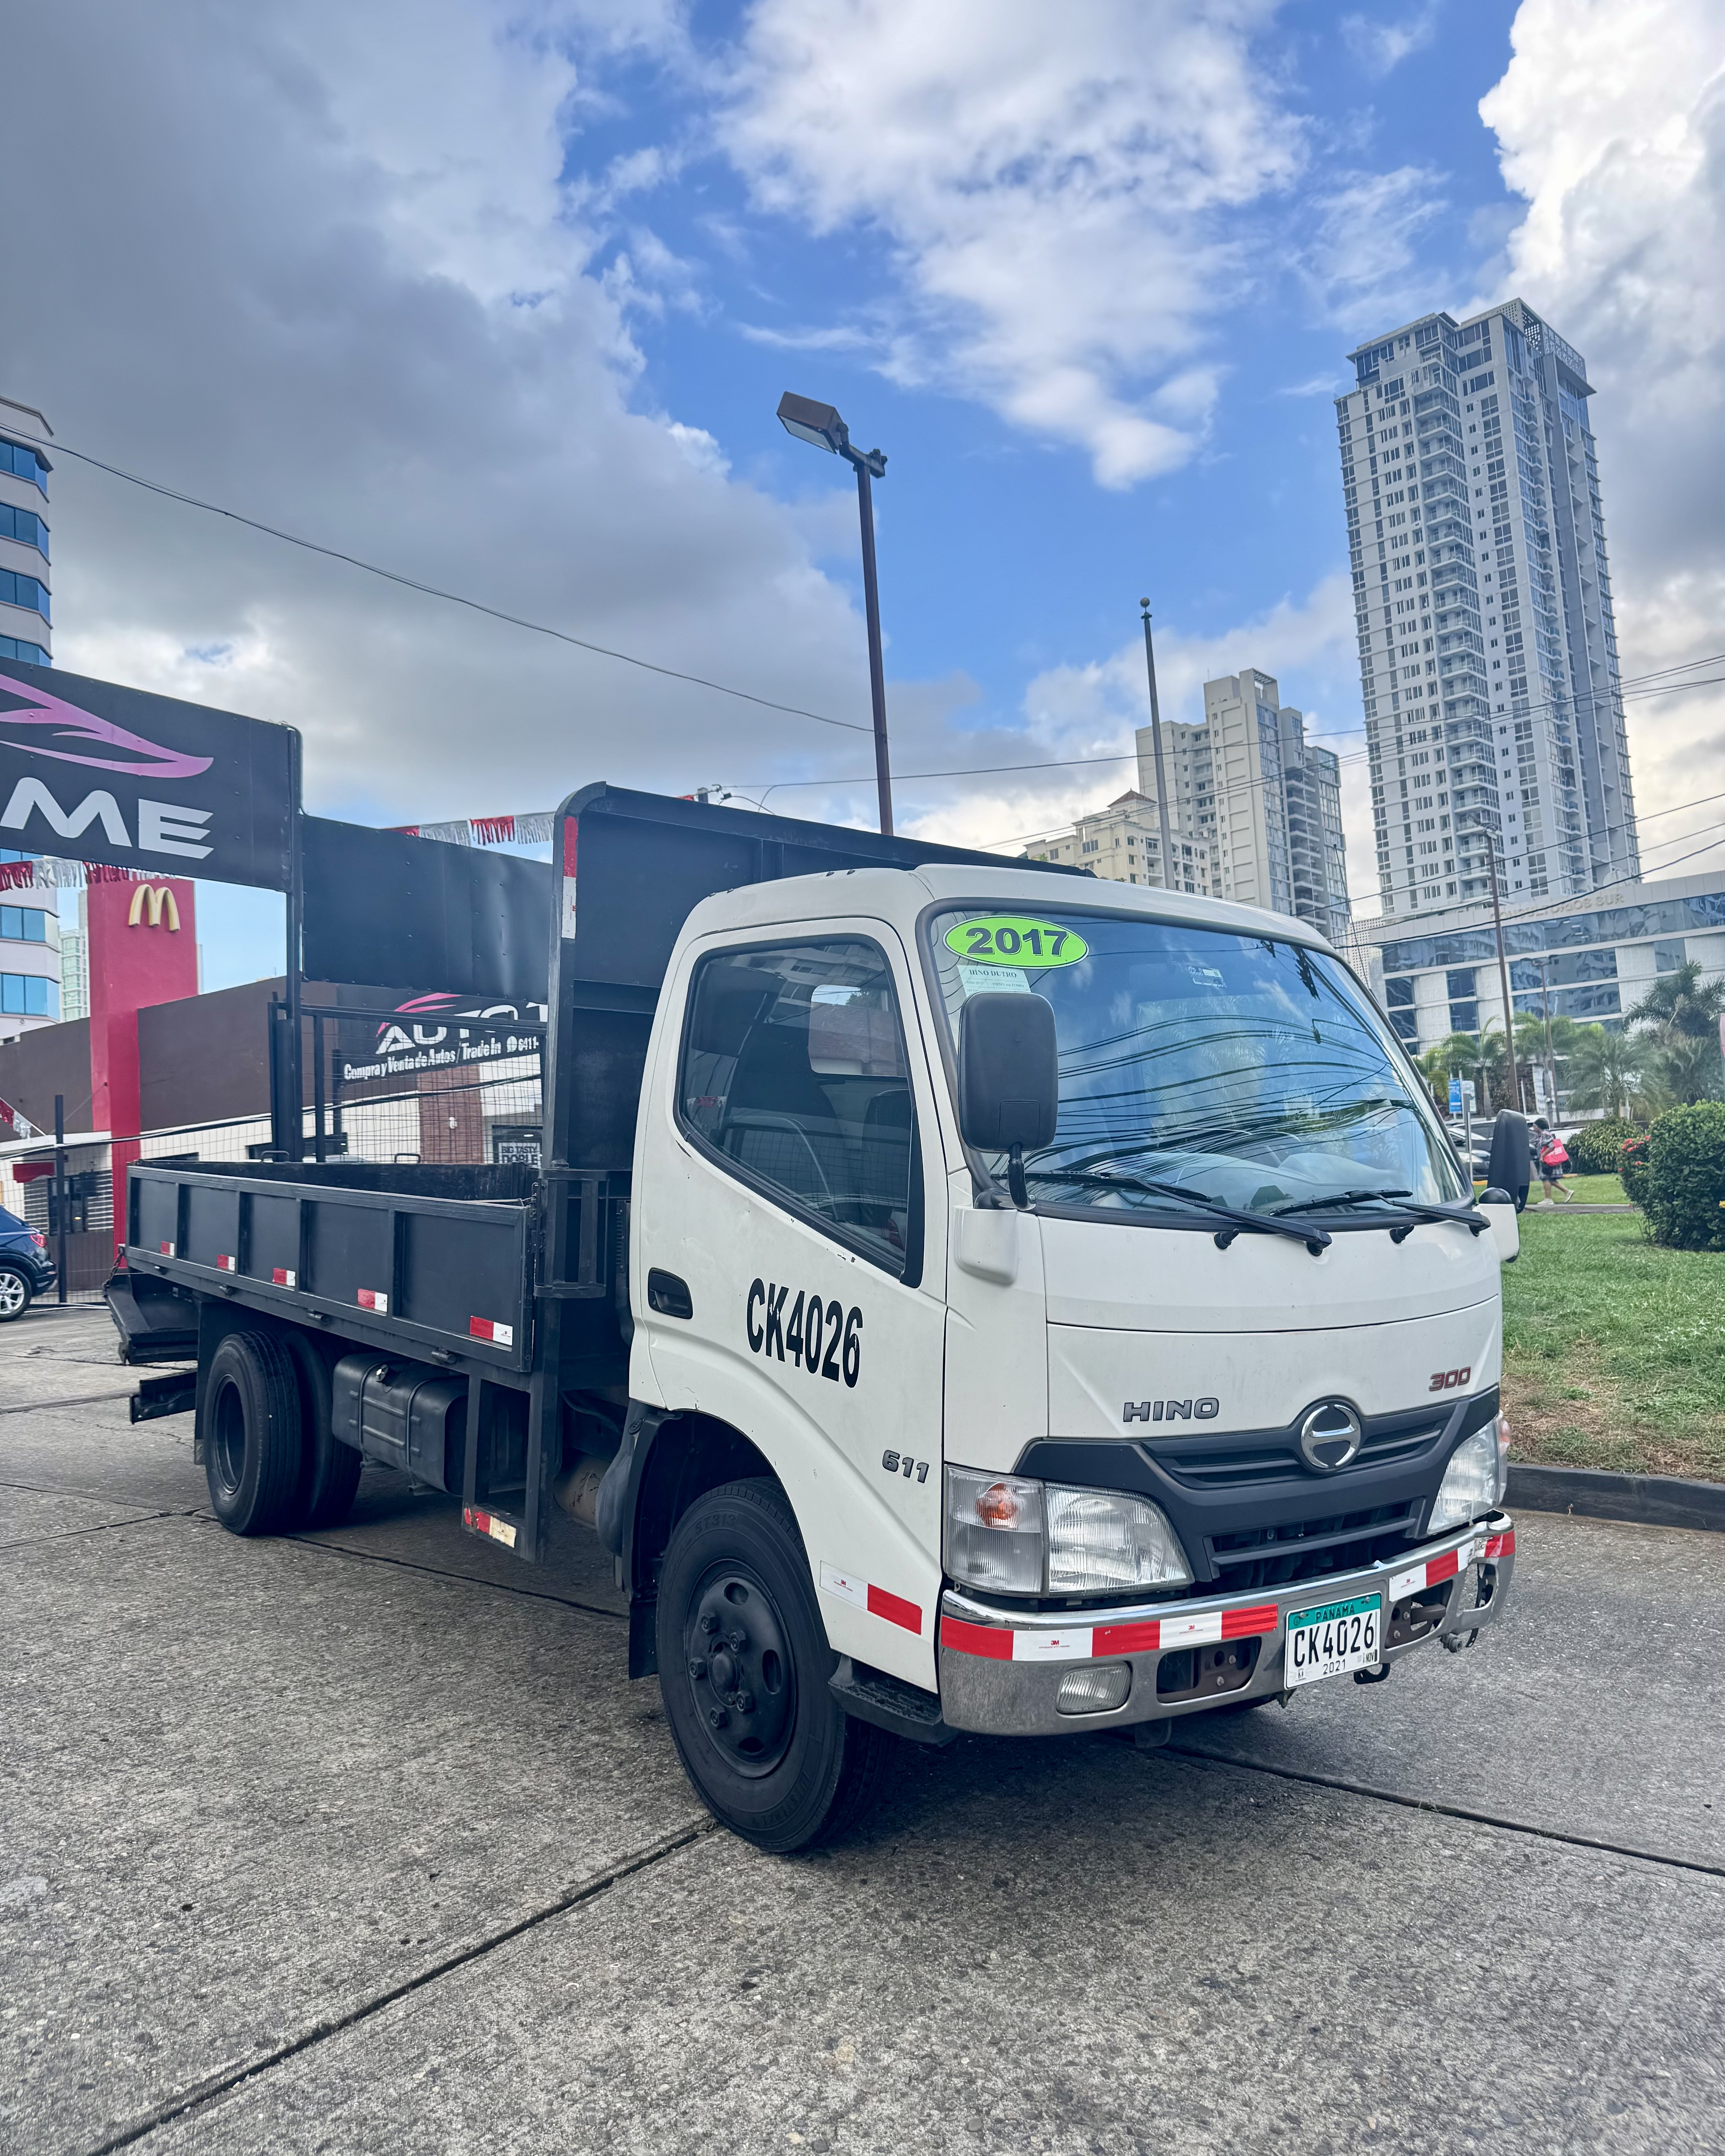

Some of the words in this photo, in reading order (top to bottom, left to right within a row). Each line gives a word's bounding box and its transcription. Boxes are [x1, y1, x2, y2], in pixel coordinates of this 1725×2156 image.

[0, 777, 214, 859] ME
[1595, 894, 1624, 906] SUR
[966, 927, 1069, 956] 2017
[344, 1064, 380, 1080] Compra
[381, 1063, 387, 1077] y
[387, 1055, 414, 1073] Venta
[415, 1051, 427, 1068] de
[428, 1049, 455, 1066] Autos
[461, 1040, 490, 1060] Trade
[490, 1038, 501, 1055] In
[747, 1278, 863, 1388] CK4026
[1429, 1366, 1471, 1391] 300
[1123, 1398, 1219, 1422] HINO
[882, 1450, 929, 1484] 611
[1315, 1603, 1355, 1623] PANAMA
[1294, 1613, 1374, 1667] CK4026
[1322, 1658, 1346, 1675] 2021
[1365, 1651, 1374, 1663] NOV
